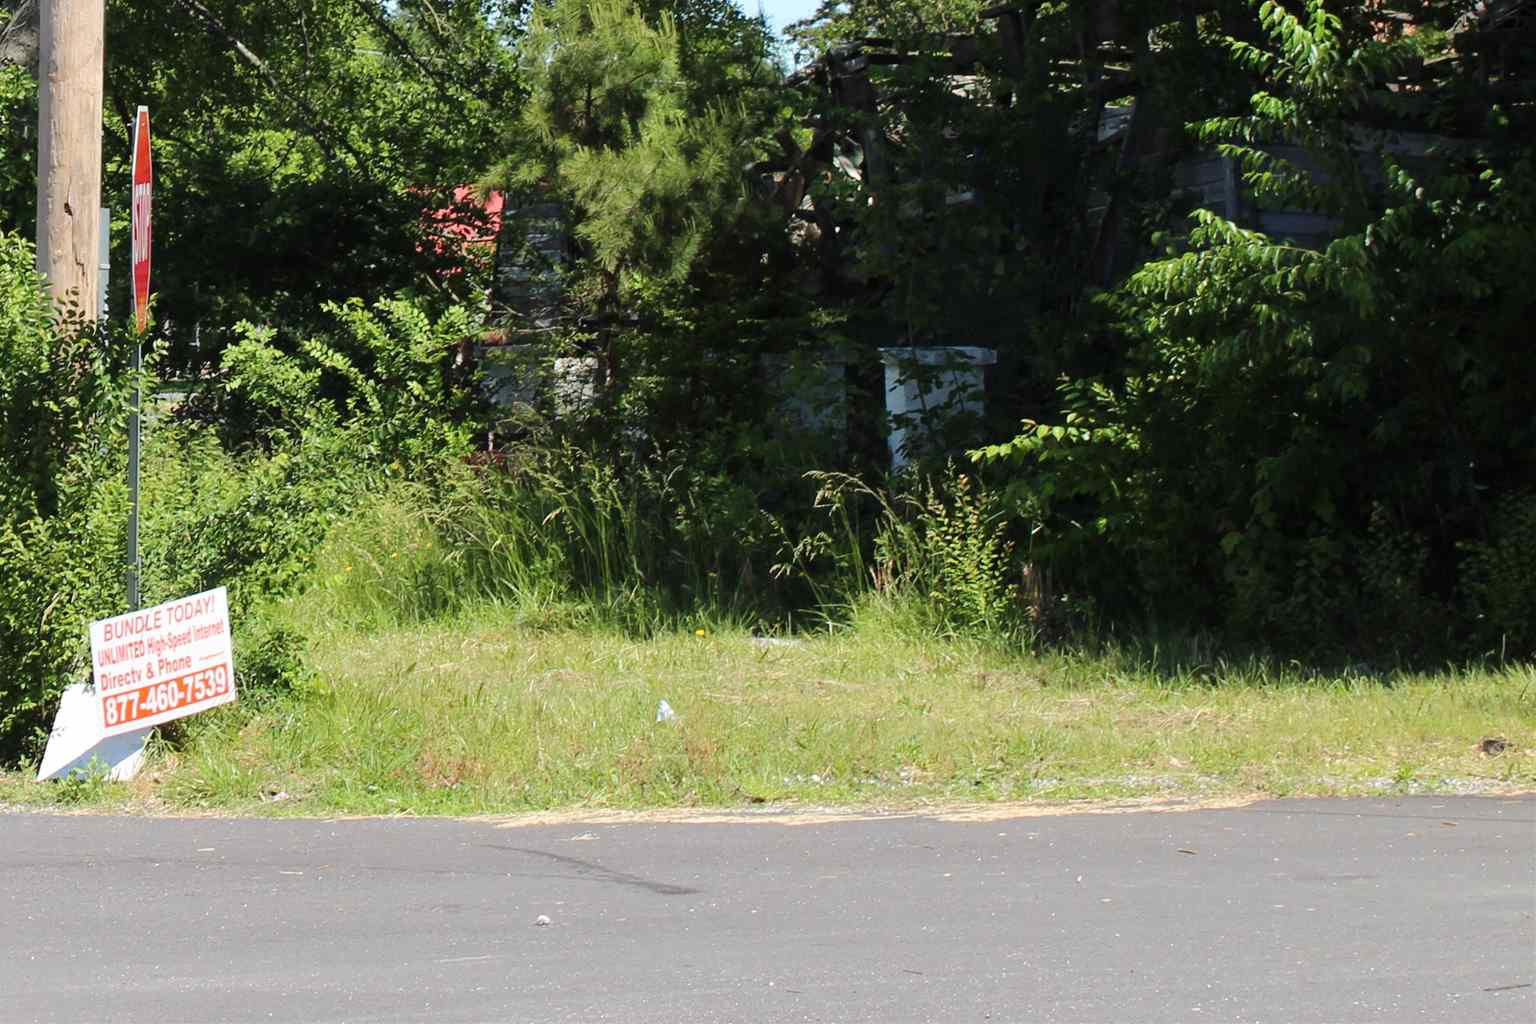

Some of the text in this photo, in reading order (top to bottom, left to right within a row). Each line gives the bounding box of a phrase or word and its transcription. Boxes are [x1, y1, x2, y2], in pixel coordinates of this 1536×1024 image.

[98, 618, 224, 667] UNLIMITED High-Speed Internet
[104, 595, 216, 642] BUNDLE TODAY!
[101, 669, 142, 691] Directv
[146, 662, 154, 678] &
[158, 654, 192, 674] Phone
[105, 666, 226, 724] 877-460-7539
